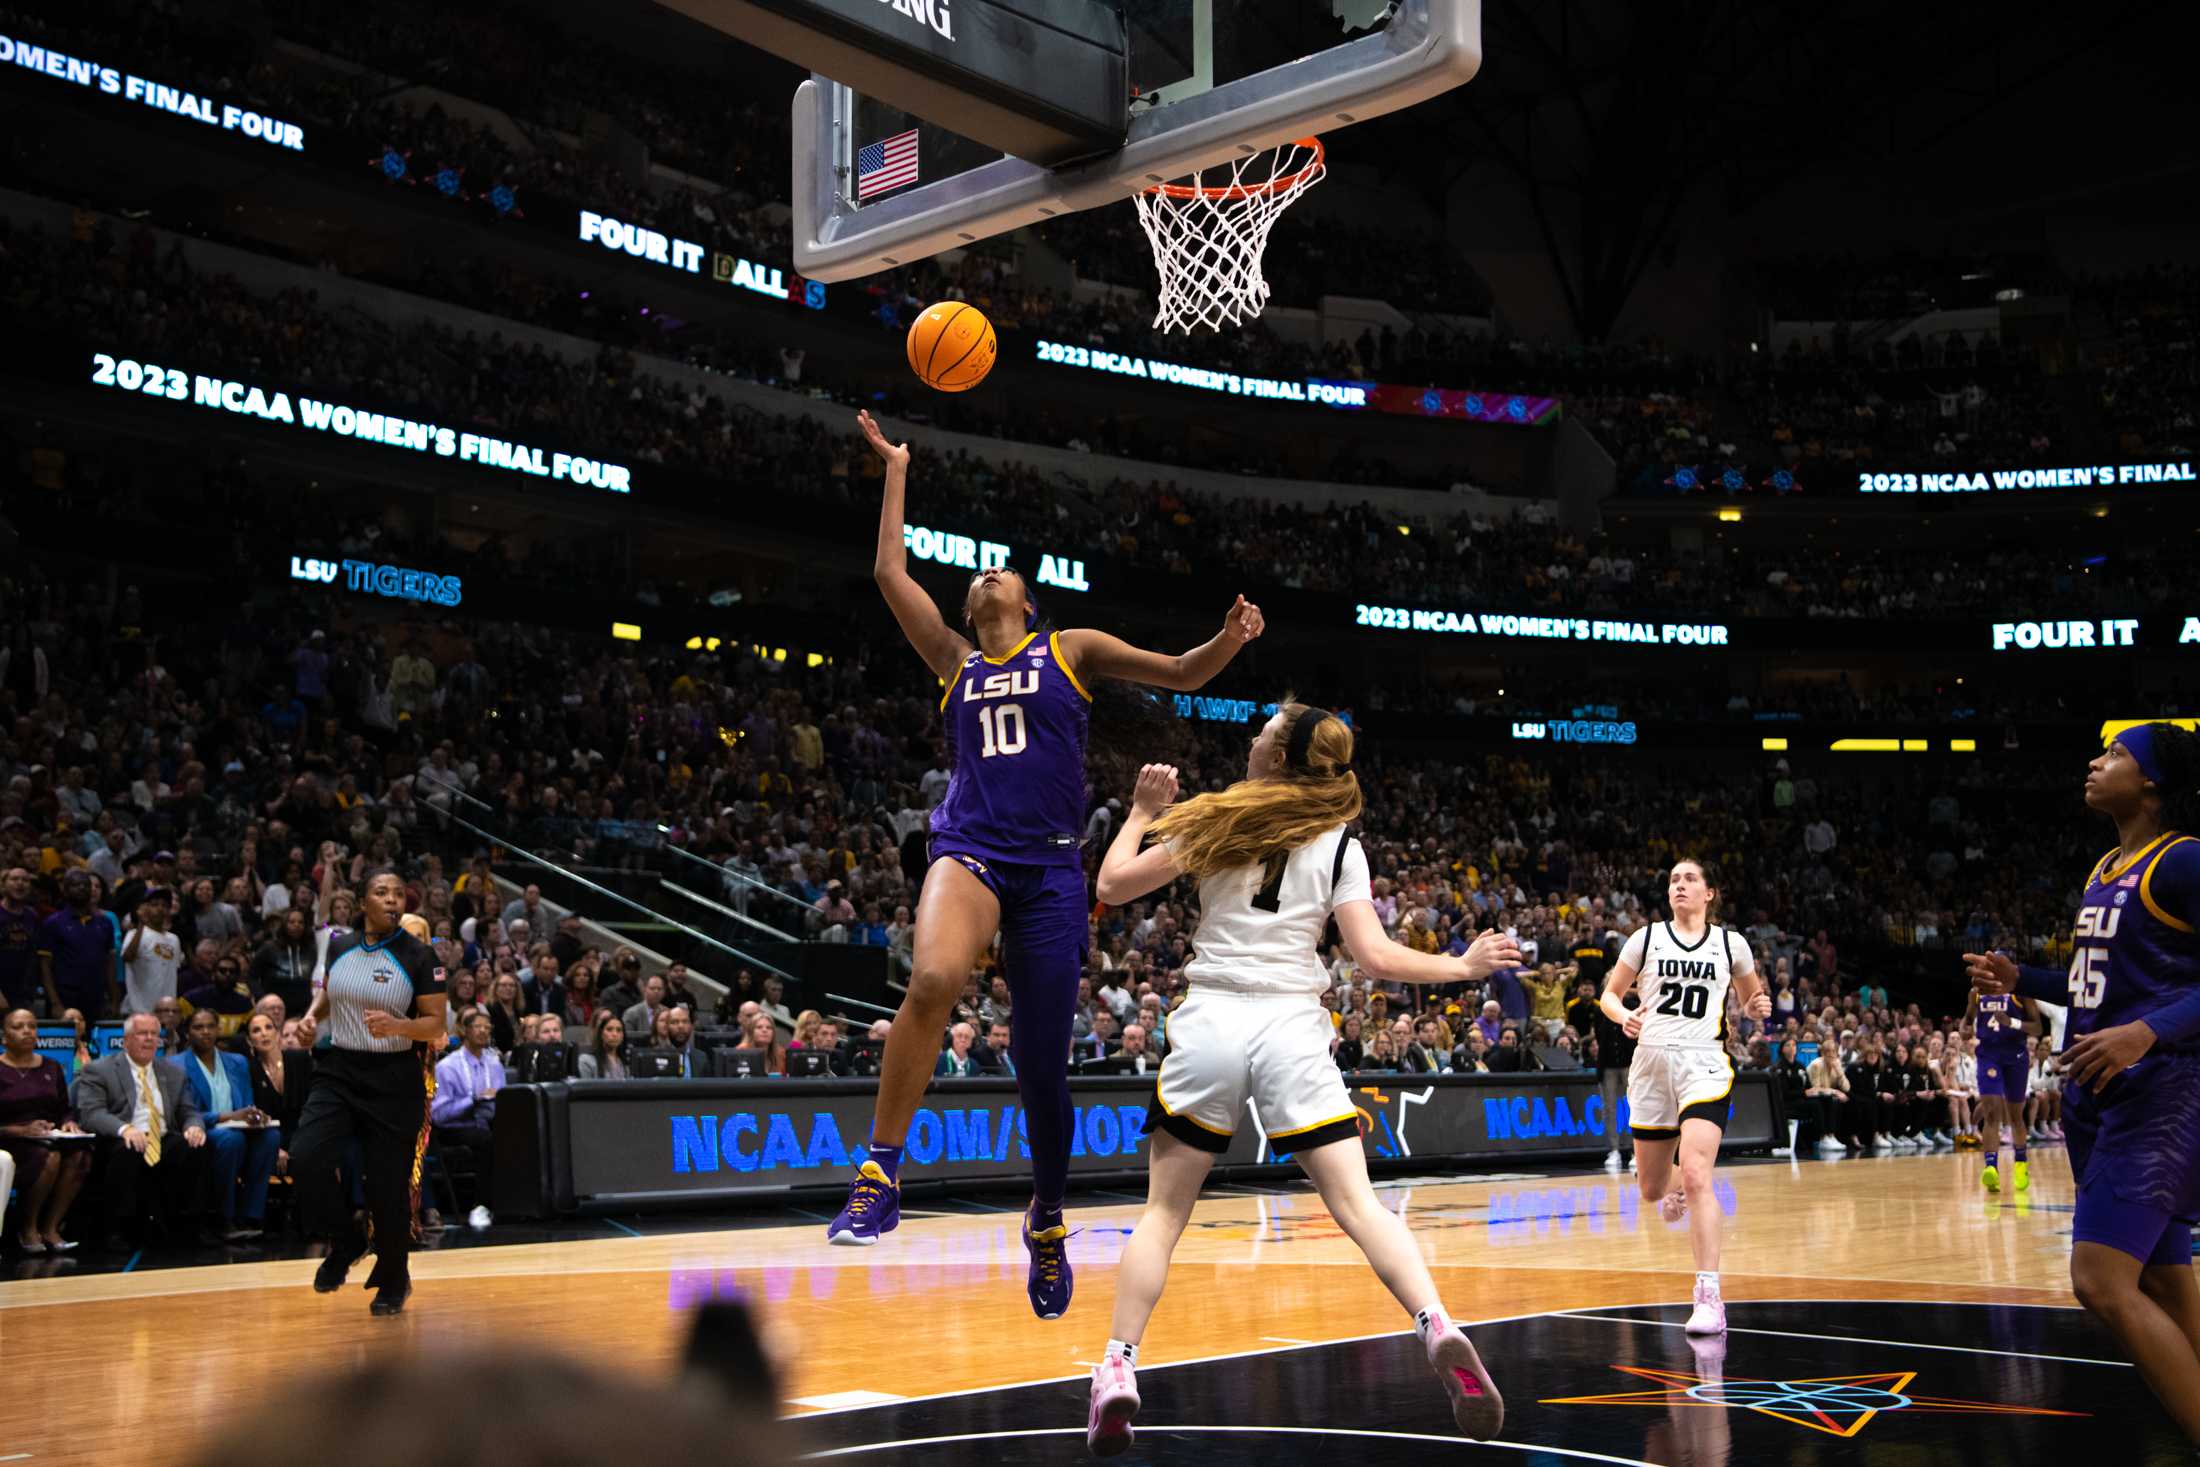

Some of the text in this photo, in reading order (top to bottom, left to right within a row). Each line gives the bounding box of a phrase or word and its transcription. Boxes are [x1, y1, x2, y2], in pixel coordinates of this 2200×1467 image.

[125, 75, 219, 124] FINAL
[223, 104, 304, 150] FOUR
[579, 210, 669, 264] FOUR
[672, 238, 704, 274] IT
[1037, 340, 1366, 406] 2023 NCAA WOMEN'S FINAL FOUR
[92, 353, 630, 493] 2023 NCAA WOMEN'S FINAL FOUR
[1859, 462, 2197, 492] 2023 NCAA WOMEN'S FINAL
[291, 556, 462, 607] LSU TIGERS
[1036, 554, 1090, 593] ALL
[1355, 604, 1728, 645] 2023 NCAA WOMEN'S FINAL FOUR
[1992, 620, 2096, 650] FOUR
[2101, 619, 2139, 646] IT
[963, 670, 1040, 702] LSU
[978, 703, 1027, 758] 10
[1512, 719, 1637, 744] LSU TIGERS
[2076, 906, 2122, 938] SU
[1657, 959, 1717, 981] IOWA
[2068, 947, 2110, 1009] 45
[1656, 982, 1710, 1019] 20
[1980, 1001, 2008, 1012] LSU
[1987, 1015, 2000, 1032] 4
[670, 1104, 1149, 1173] NCAA.OM/OP
